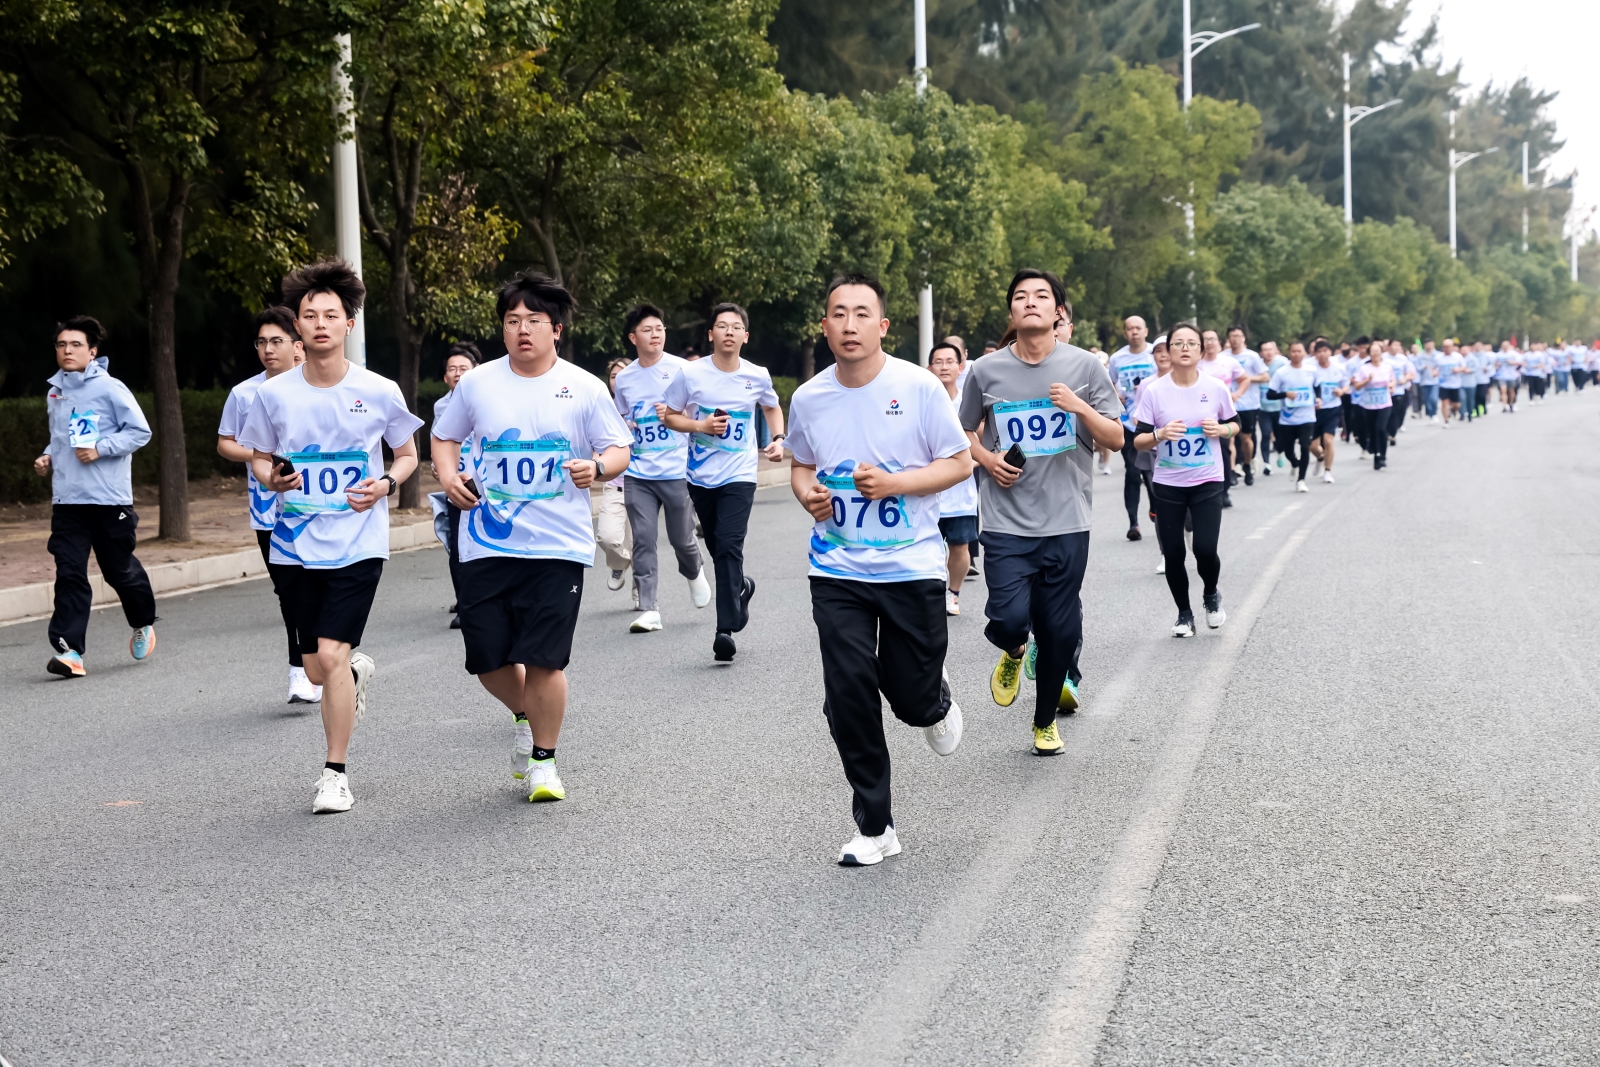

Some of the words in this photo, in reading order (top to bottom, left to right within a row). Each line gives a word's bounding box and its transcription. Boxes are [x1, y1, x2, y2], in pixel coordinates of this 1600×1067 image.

[1007, 411, 1067, 443] 092
[1164, 437, 1206, 457] 192
[300, 466, 362, 496] 102
[497, 456, 555, 485] 101
[831, 495, 901, 528] 076
